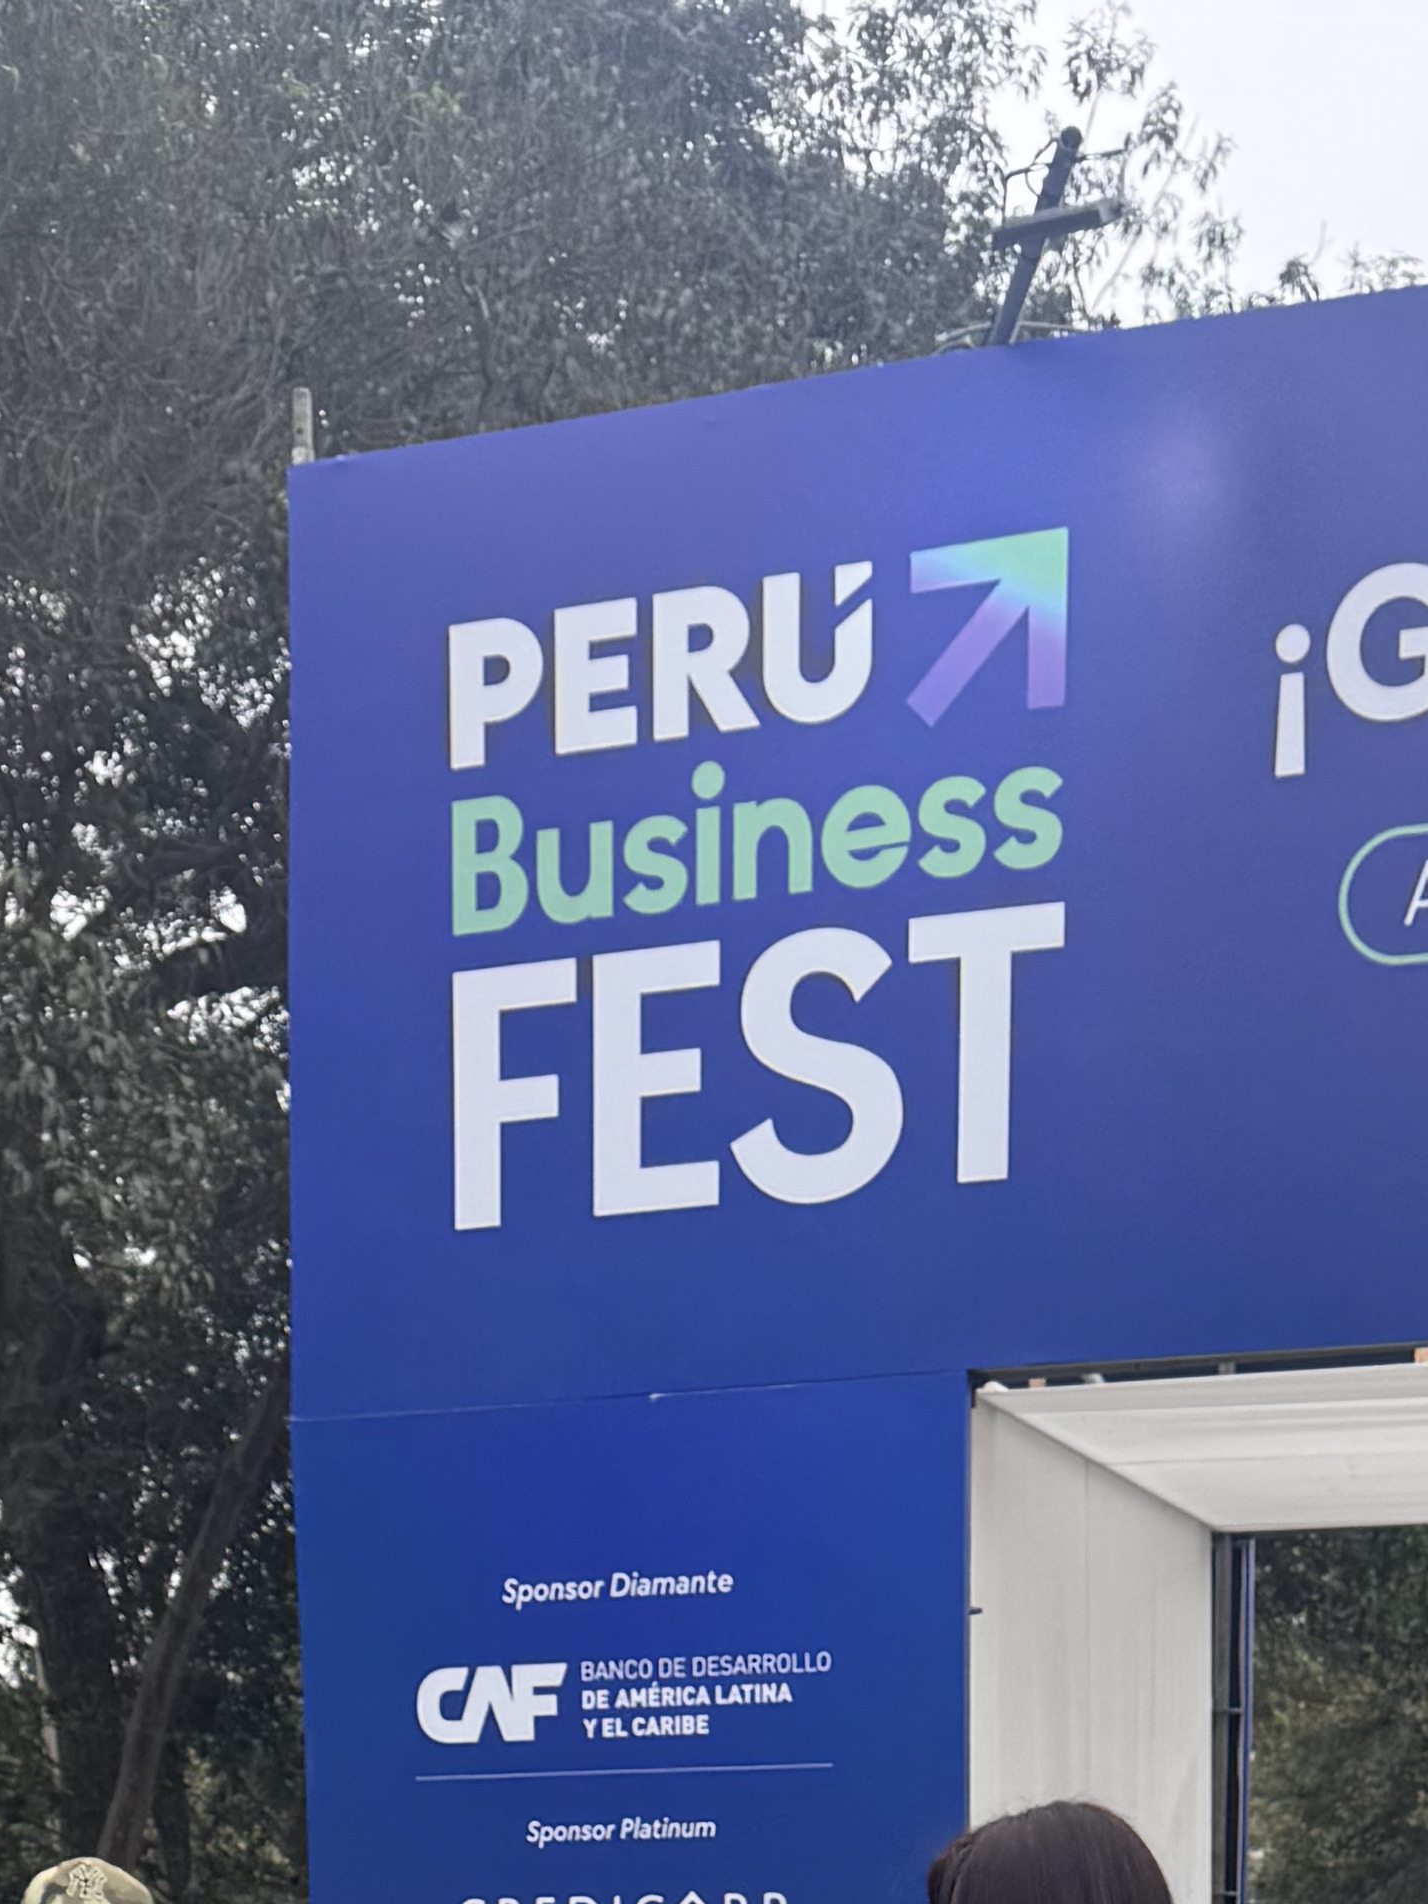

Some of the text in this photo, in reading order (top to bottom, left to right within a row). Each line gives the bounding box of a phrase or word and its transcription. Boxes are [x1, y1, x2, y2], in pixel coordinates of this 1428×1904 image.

[449, 561, 872, 770] PERÚ
[452, 761, 1063, 936] Business
[452, 902, 1065, 1231] FEST
[502, 1570, 733, 1609] Sponsor Diamante
[581, 1651, 831, 1682] BANCO DE DESARROLLO
[417, 1662, 567, 1744] CAF
[582, 1681, 792, 1709] DE AMÉRICA LATINA
[583, 1715, 709, 1738] Y EL CARIBE
[526, 1817, 716, 1848] Sponsor Platinum
